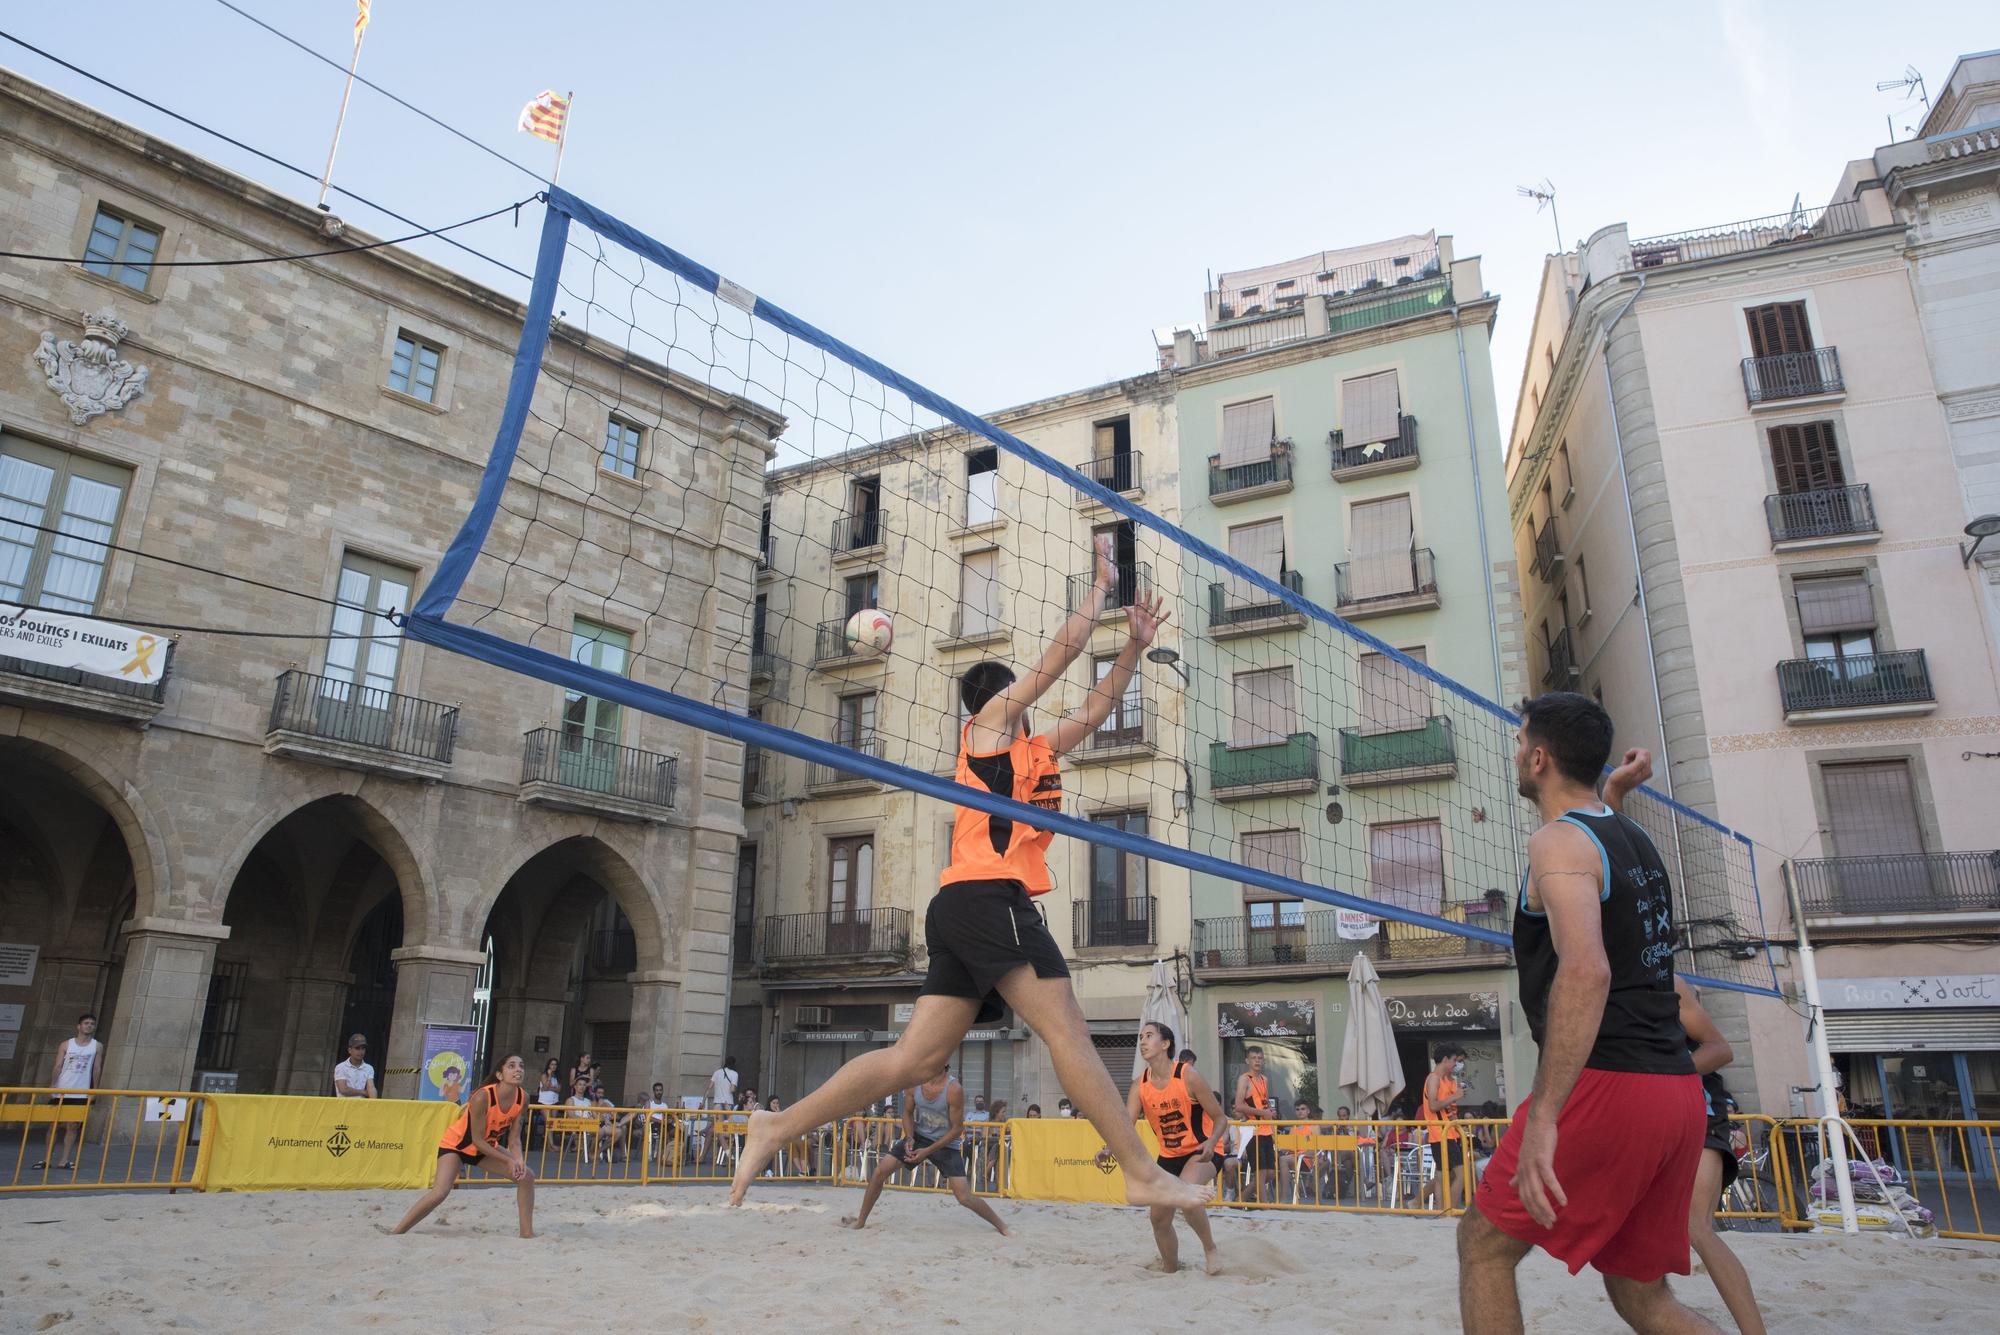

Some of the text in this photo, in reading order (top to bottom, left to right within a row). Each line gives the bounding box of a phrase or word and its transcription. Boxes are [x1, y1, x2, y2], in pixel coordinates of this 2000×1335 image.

[0, 615, 128, 651] OS POLÍTICS I EXILIATS
[16, 631, 35, 642] AND
[37, 635, 63, 648] EXILES
[1936, 978, 1995, 999] d'art
[1388, 1000, 1470, 1019] Do ut des
[268, 1137, 403, 1149] Ajuntament de Manresa
